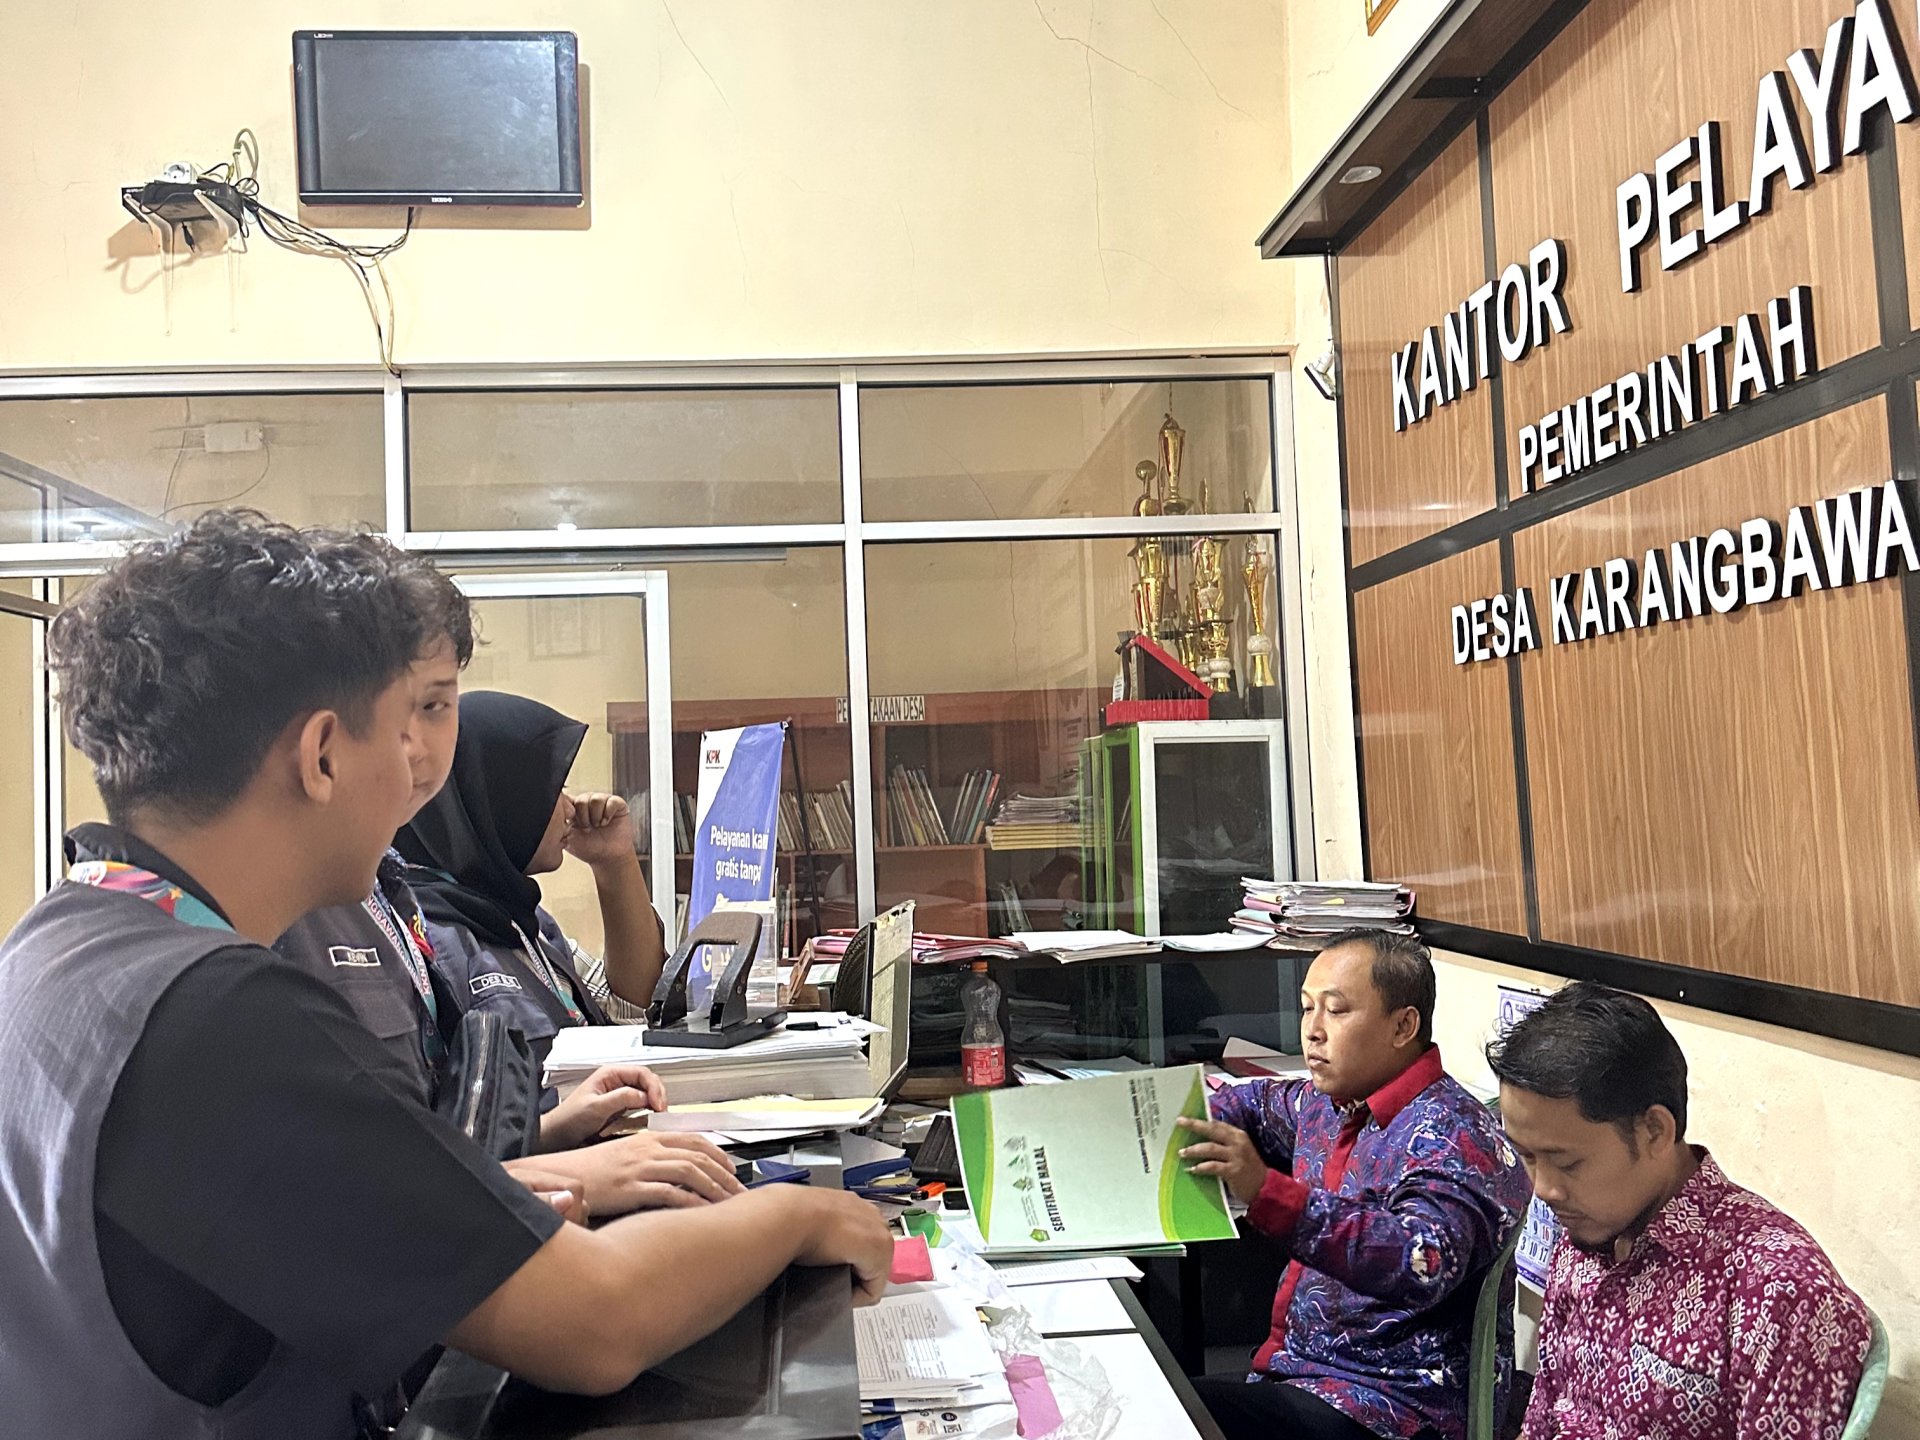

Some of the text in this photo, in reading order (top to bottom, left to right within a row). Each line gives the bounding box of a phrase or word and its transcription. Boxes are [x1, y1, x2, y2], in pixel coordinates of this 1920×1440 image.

[1391, 0, 1920, 432] KANTOR PELAYA
[1518, 285, 1817, 493] PEMERINTAH
[1451, 479, 1920, 665] DESA KARANGBAWA
[903, 696, 924, 720] DESA
[706, 749, 720, 764] KPK
[710, 825, 751, 852] Pelayanan
[1033, 1146, 1065, 1232] SERTIFIKAT HALAL
[1533, 1220, 1538, 1235] 9
[1542, 1225, 1550, 1242] 16
[1520, 1236, 1549, 1263] 3 10 17
